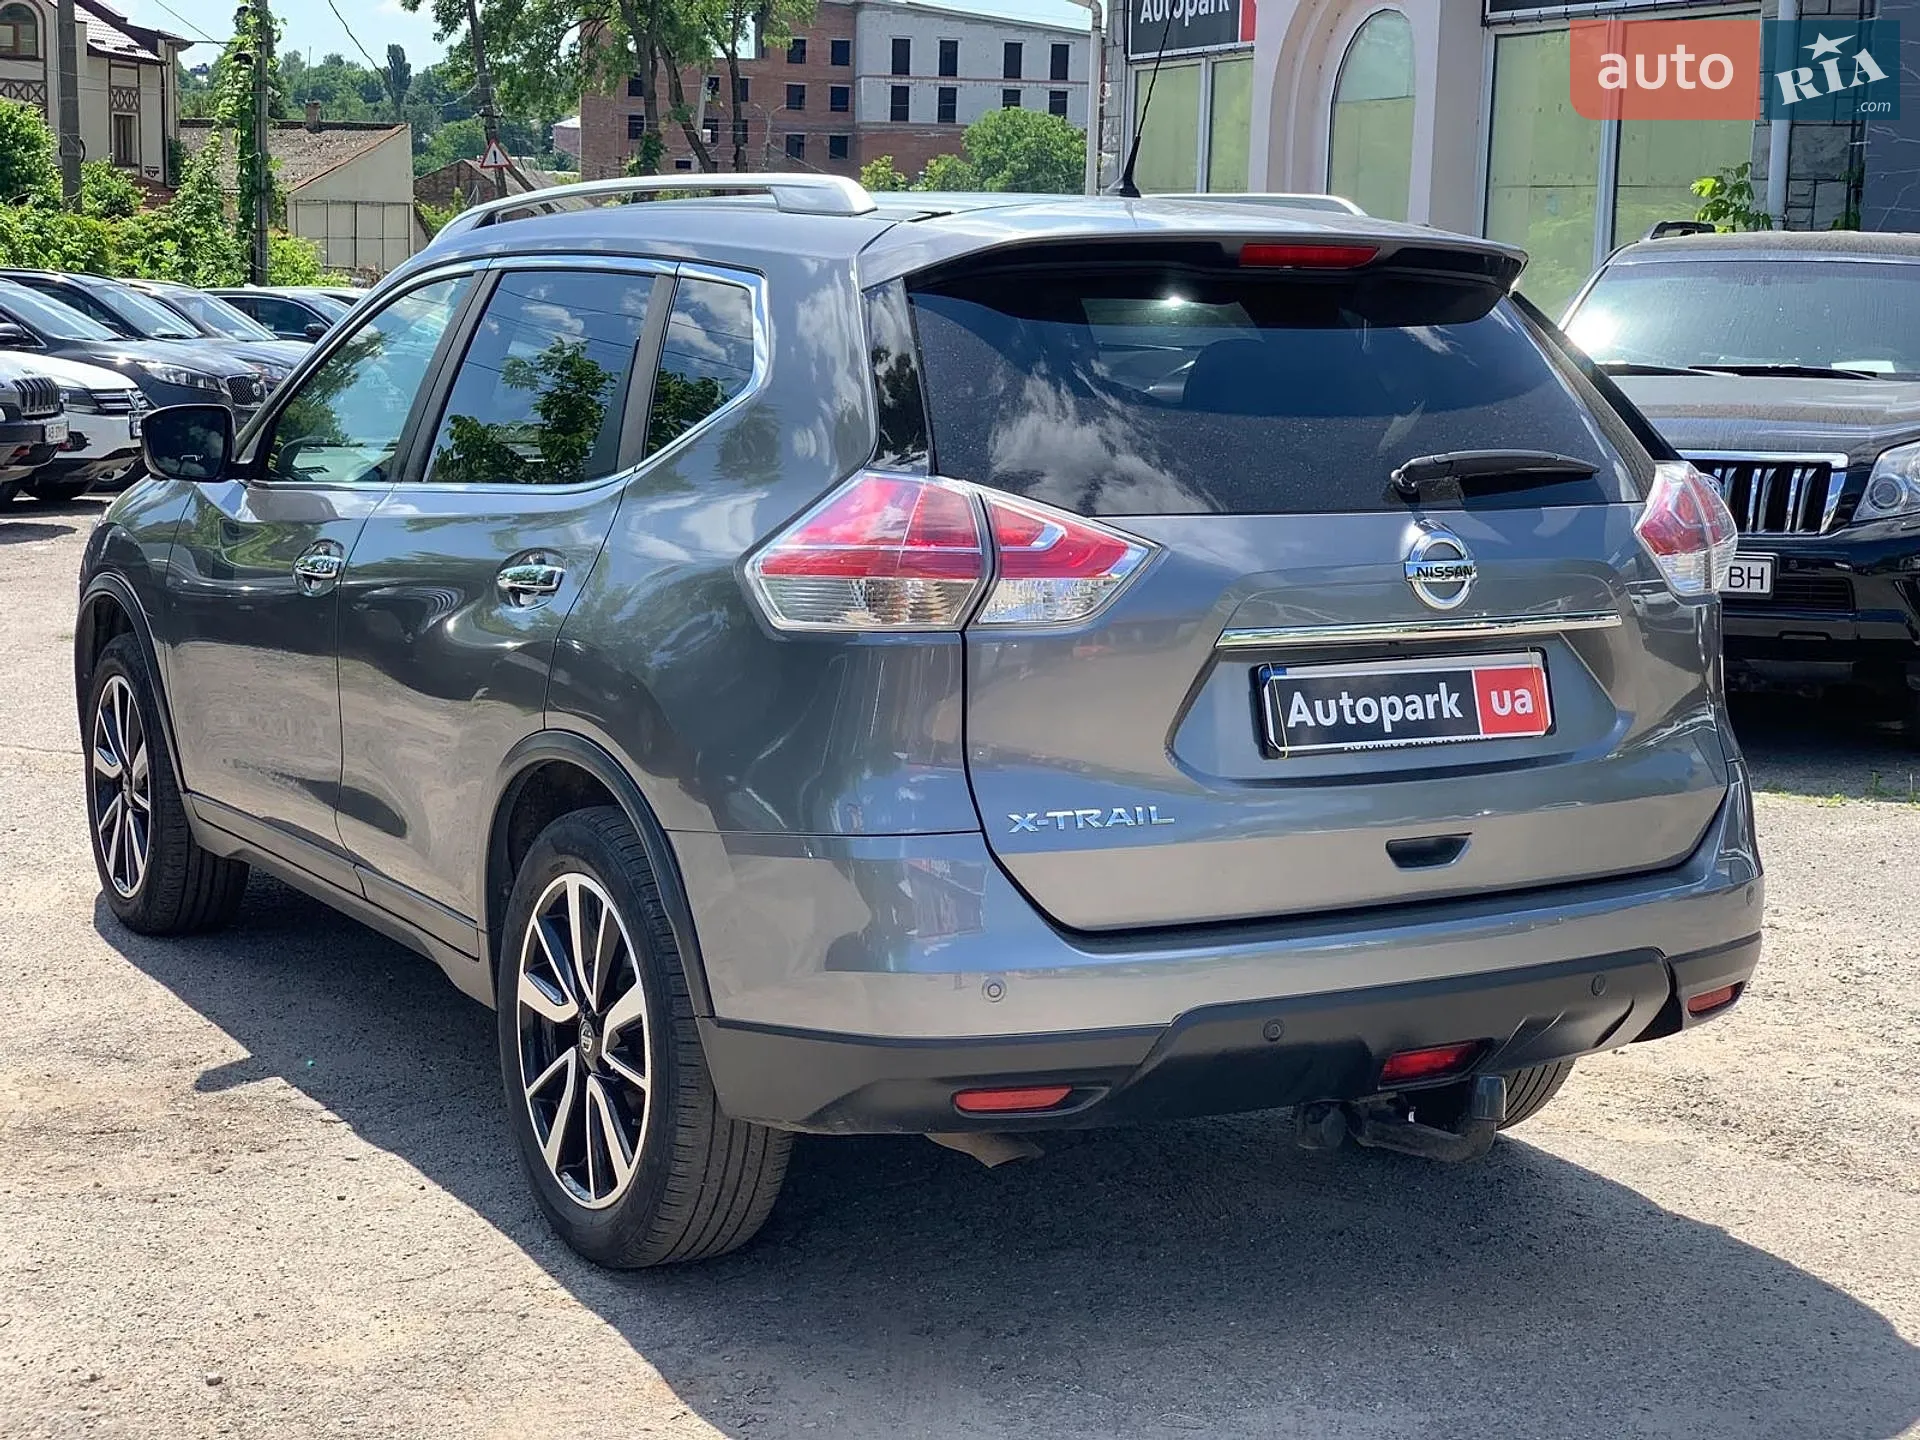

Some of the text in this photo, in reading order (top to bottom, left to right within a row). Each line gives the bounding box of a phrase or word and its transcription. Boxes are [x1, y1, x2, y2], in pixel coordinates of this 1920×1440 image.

[1417, 566, 1473, 578] NISSAN
[1287, 682, 1533, 732] Autopark ua
[1007, 805, 1175, 833] X-TRAIL
